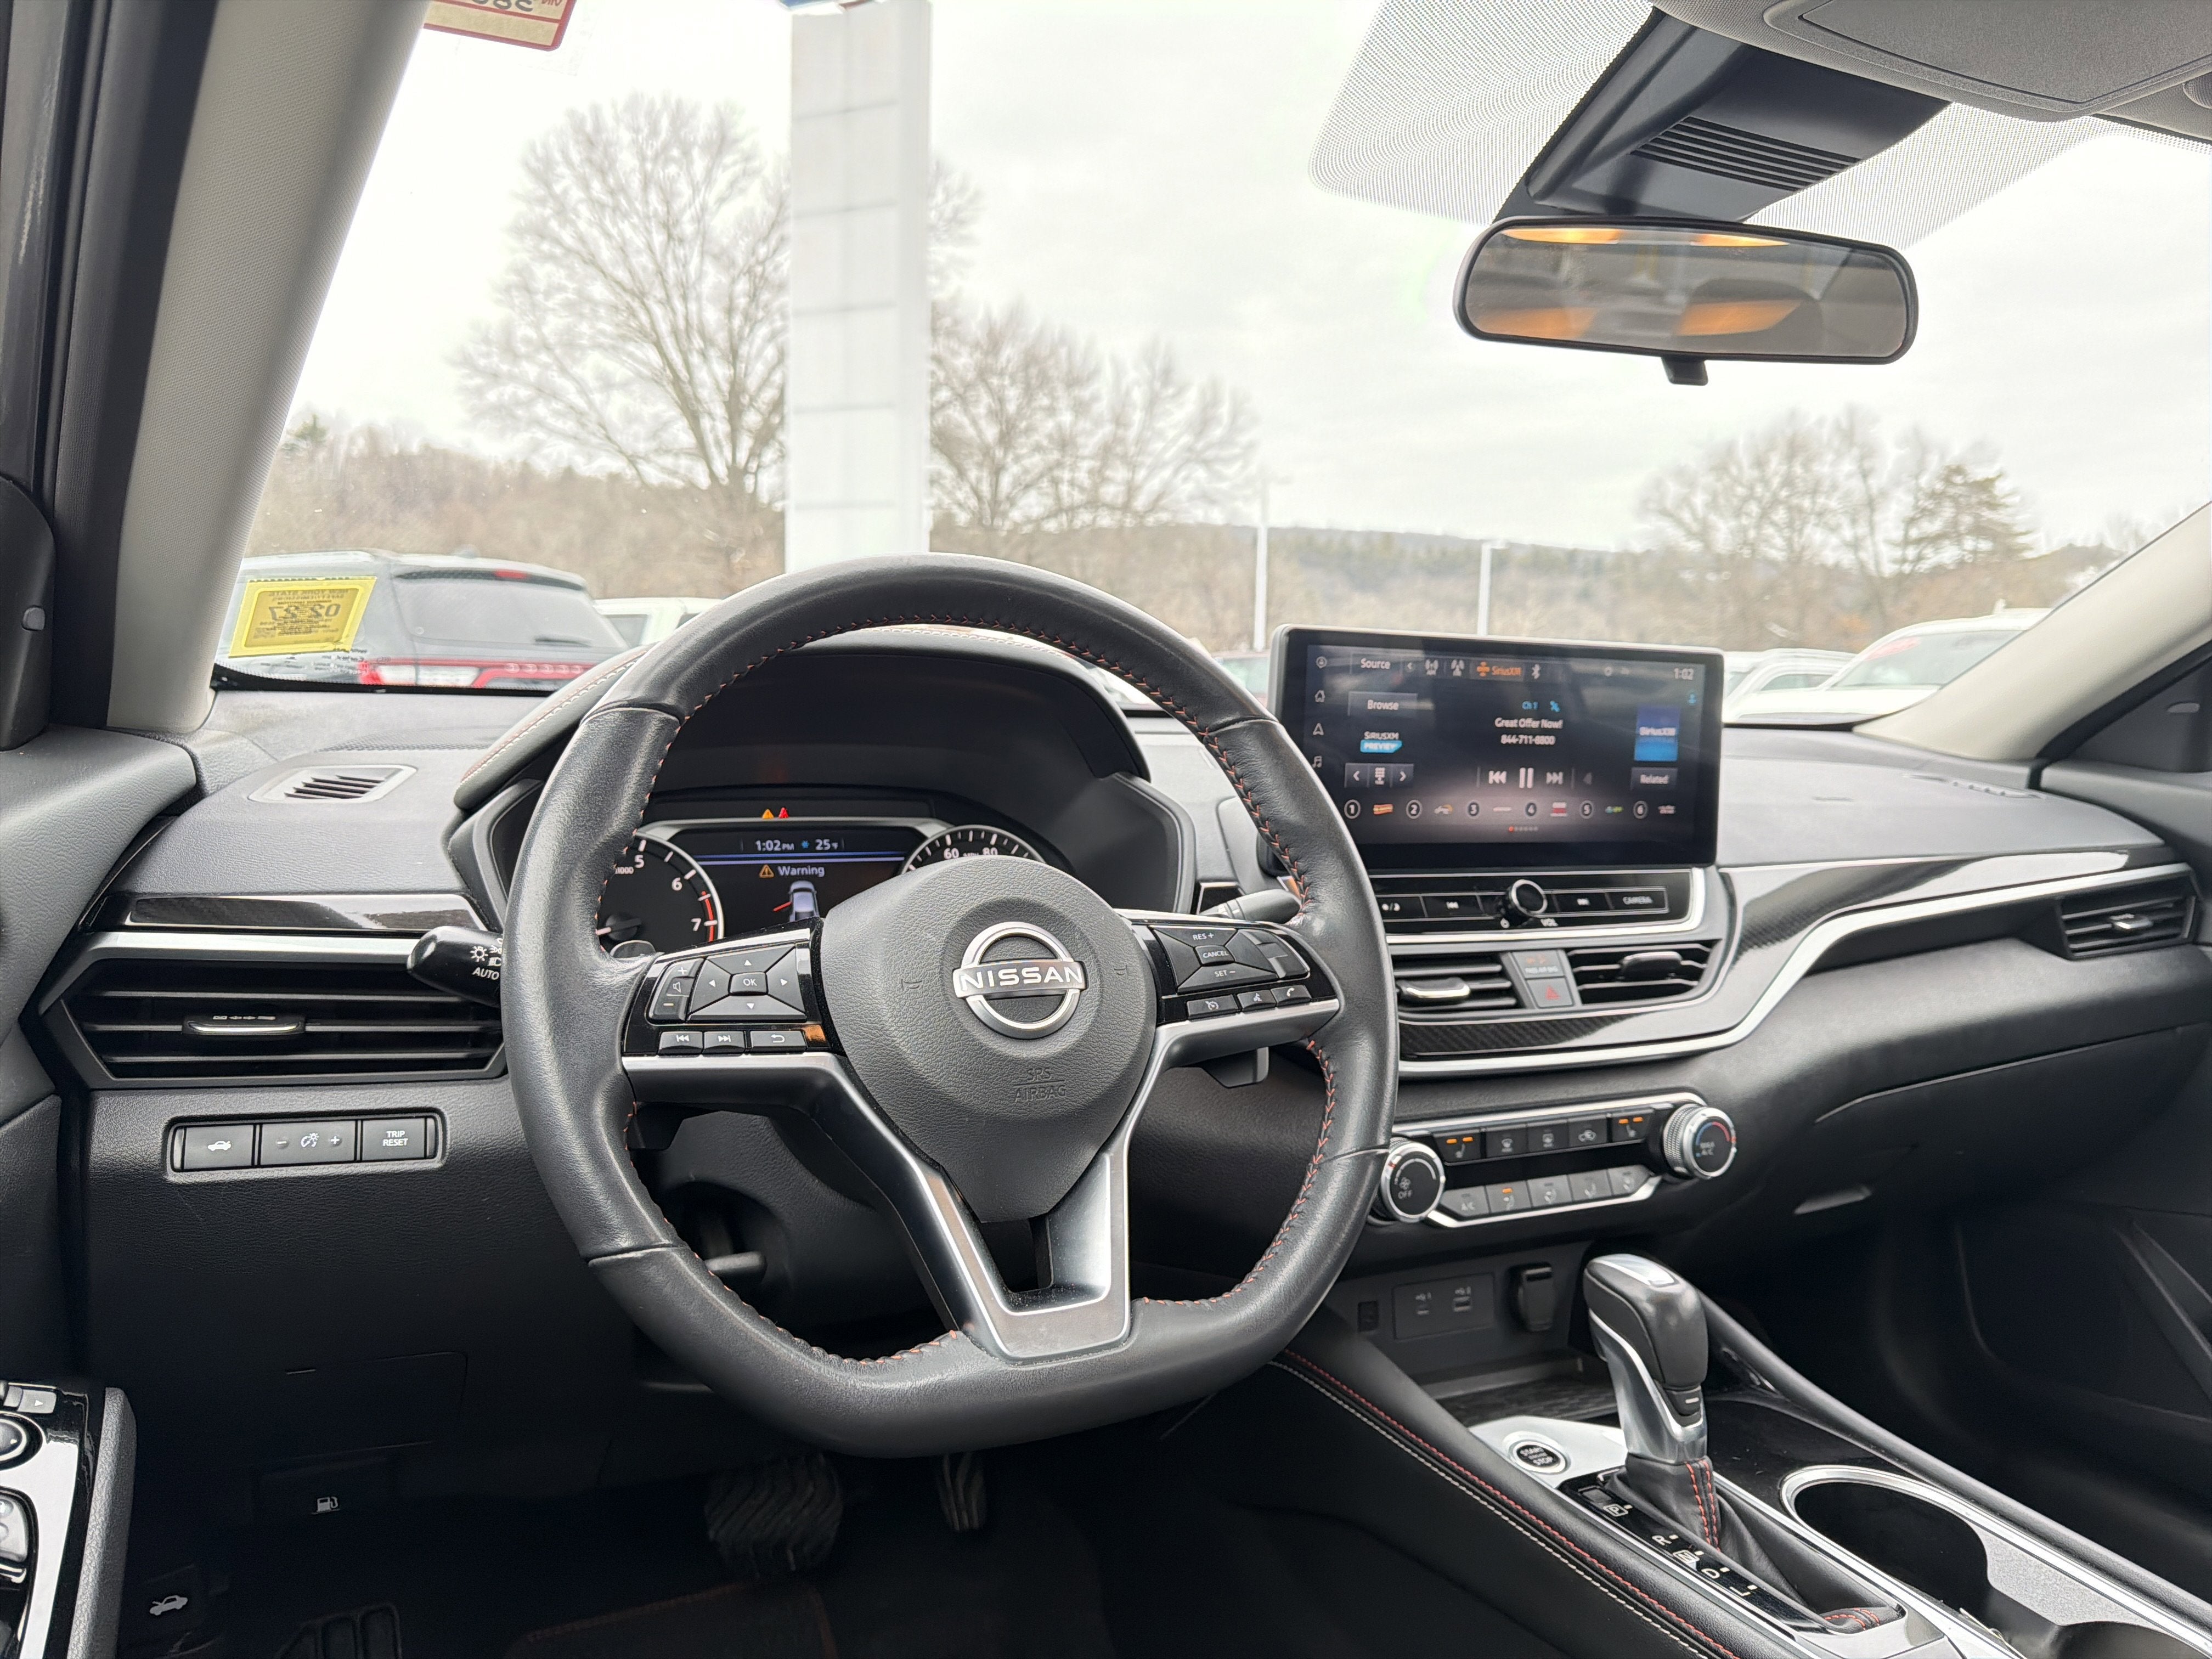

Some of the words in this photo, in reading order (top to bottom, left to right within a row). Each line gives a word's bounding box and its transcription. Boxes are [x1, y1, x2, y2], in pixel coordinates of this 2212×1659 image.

[1361, 658, 1391, 669] Source
[1674, 667, 1694, 680] 1:02
[1367, 699, 1399, 710] Browse
[1494, 717, 1518, 728] Great
[1519, 718, 1541, 729] Offer
[944, 848, 960, 859] 60
[634, 854, 645, 868] 5
[777, 865, 825, 878] Warning
[672, 877, 682, 891] 6
[691, 918, 702, 932] 7
[1202, 950, 1229, 959] CANCEL
[471, 967, 500, 980] AUTO
[961, 966, 1084, 992] NISSAN
[1214, 969, 1227, 978] SET
[743, 978, 758, 986] OK
[383, 1138, 408, 1147] RESET
[1398, 1189, 1413, 1200] OFF
[1652, 1535, 1672, 1545] R
[1701, 1568, 1720, 1579] D
